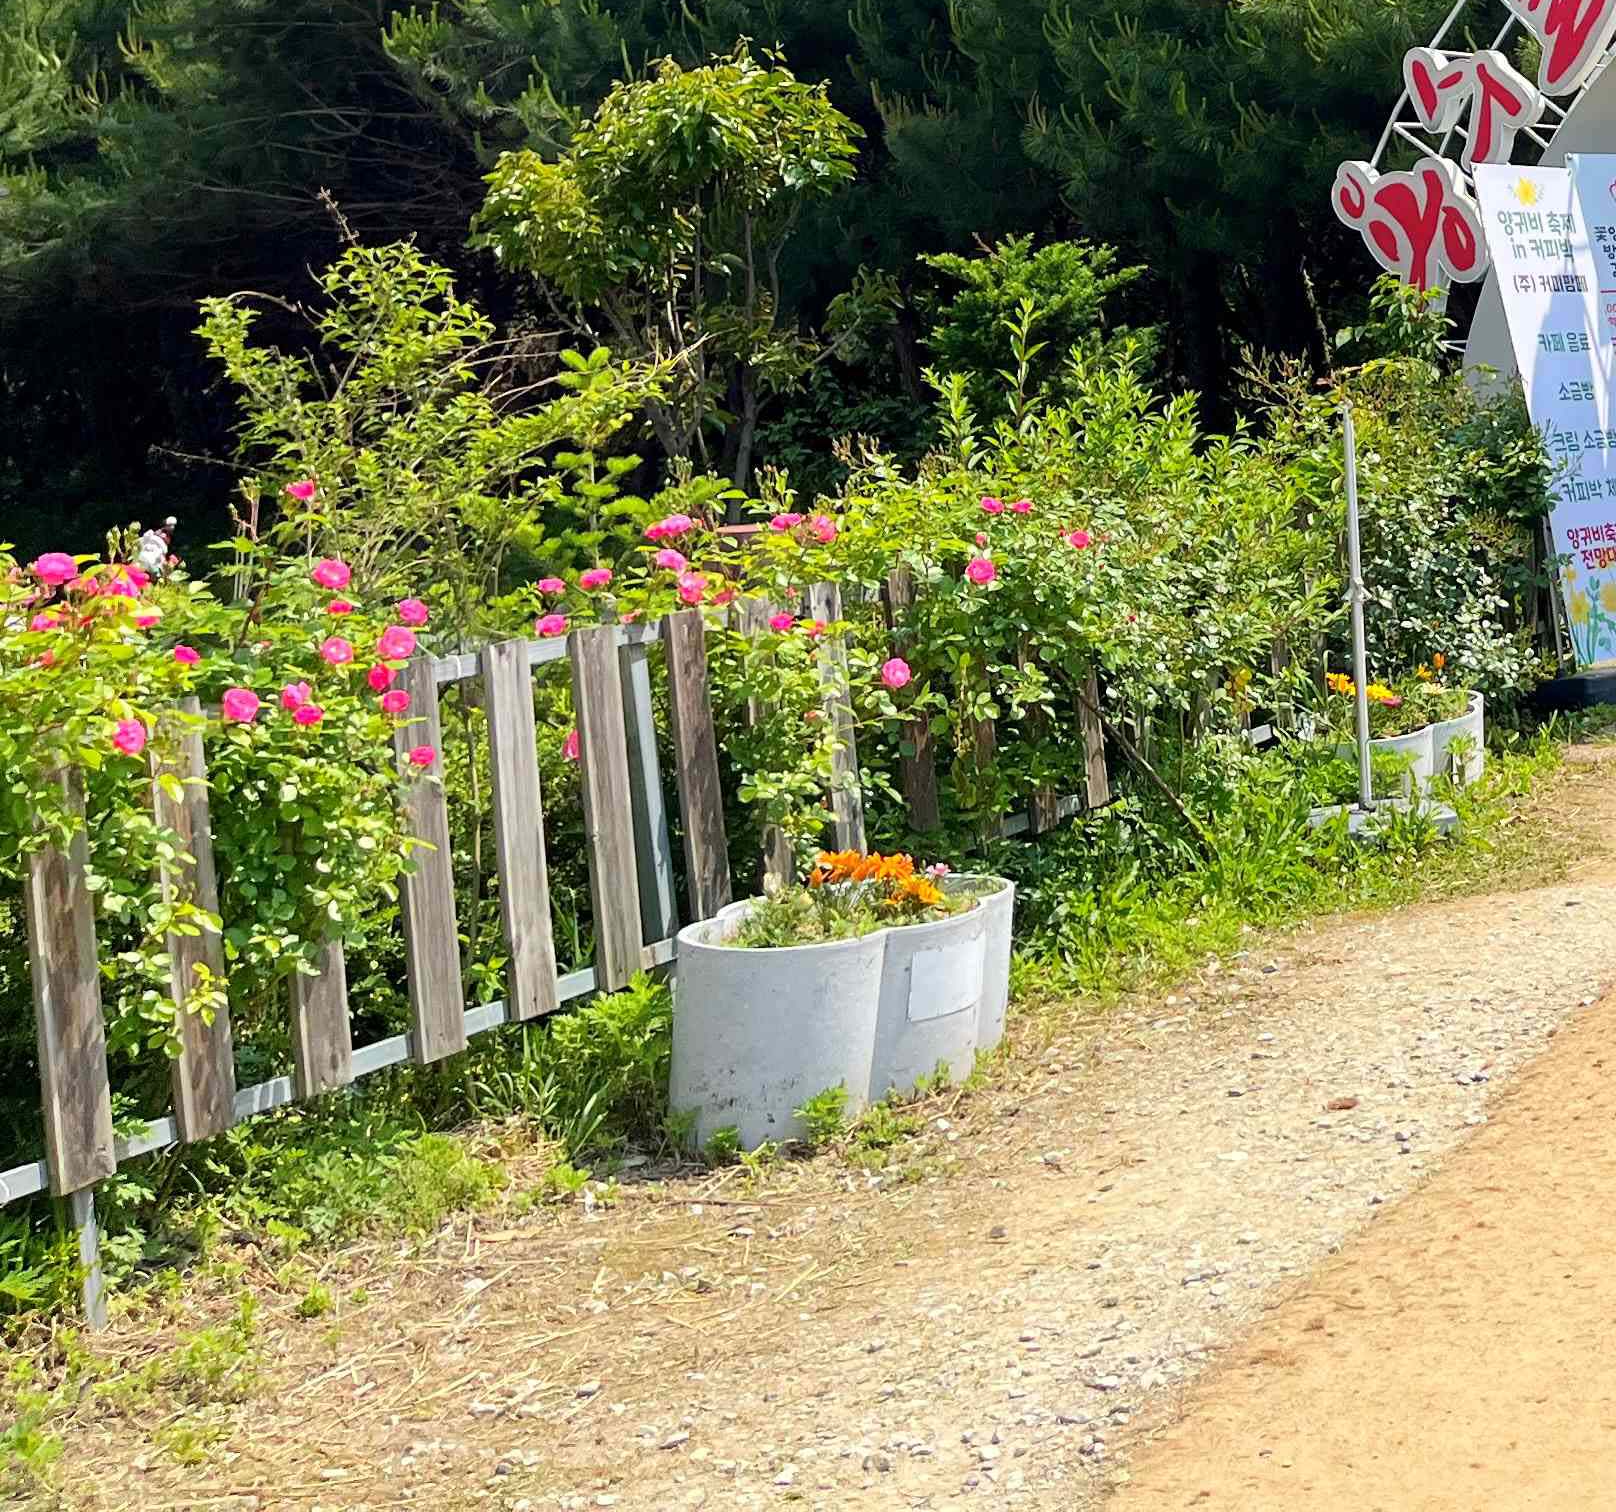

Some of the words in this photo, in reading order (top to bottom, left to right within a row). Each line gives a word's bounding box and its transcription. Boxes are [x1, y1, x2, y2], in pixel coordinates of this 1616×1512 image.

[1497, 211, 1543, 235] 양귀비
[1546, 210, 1576, 235] 축제
[1510, 237, 1527, 258] in
[1529, 238, 1575, 263] 커피박
[1538, 333, 1565, 352] 카페
[1566, 332, 1591, 352] 음료
[1553, 431, 1580, 452] 크림
